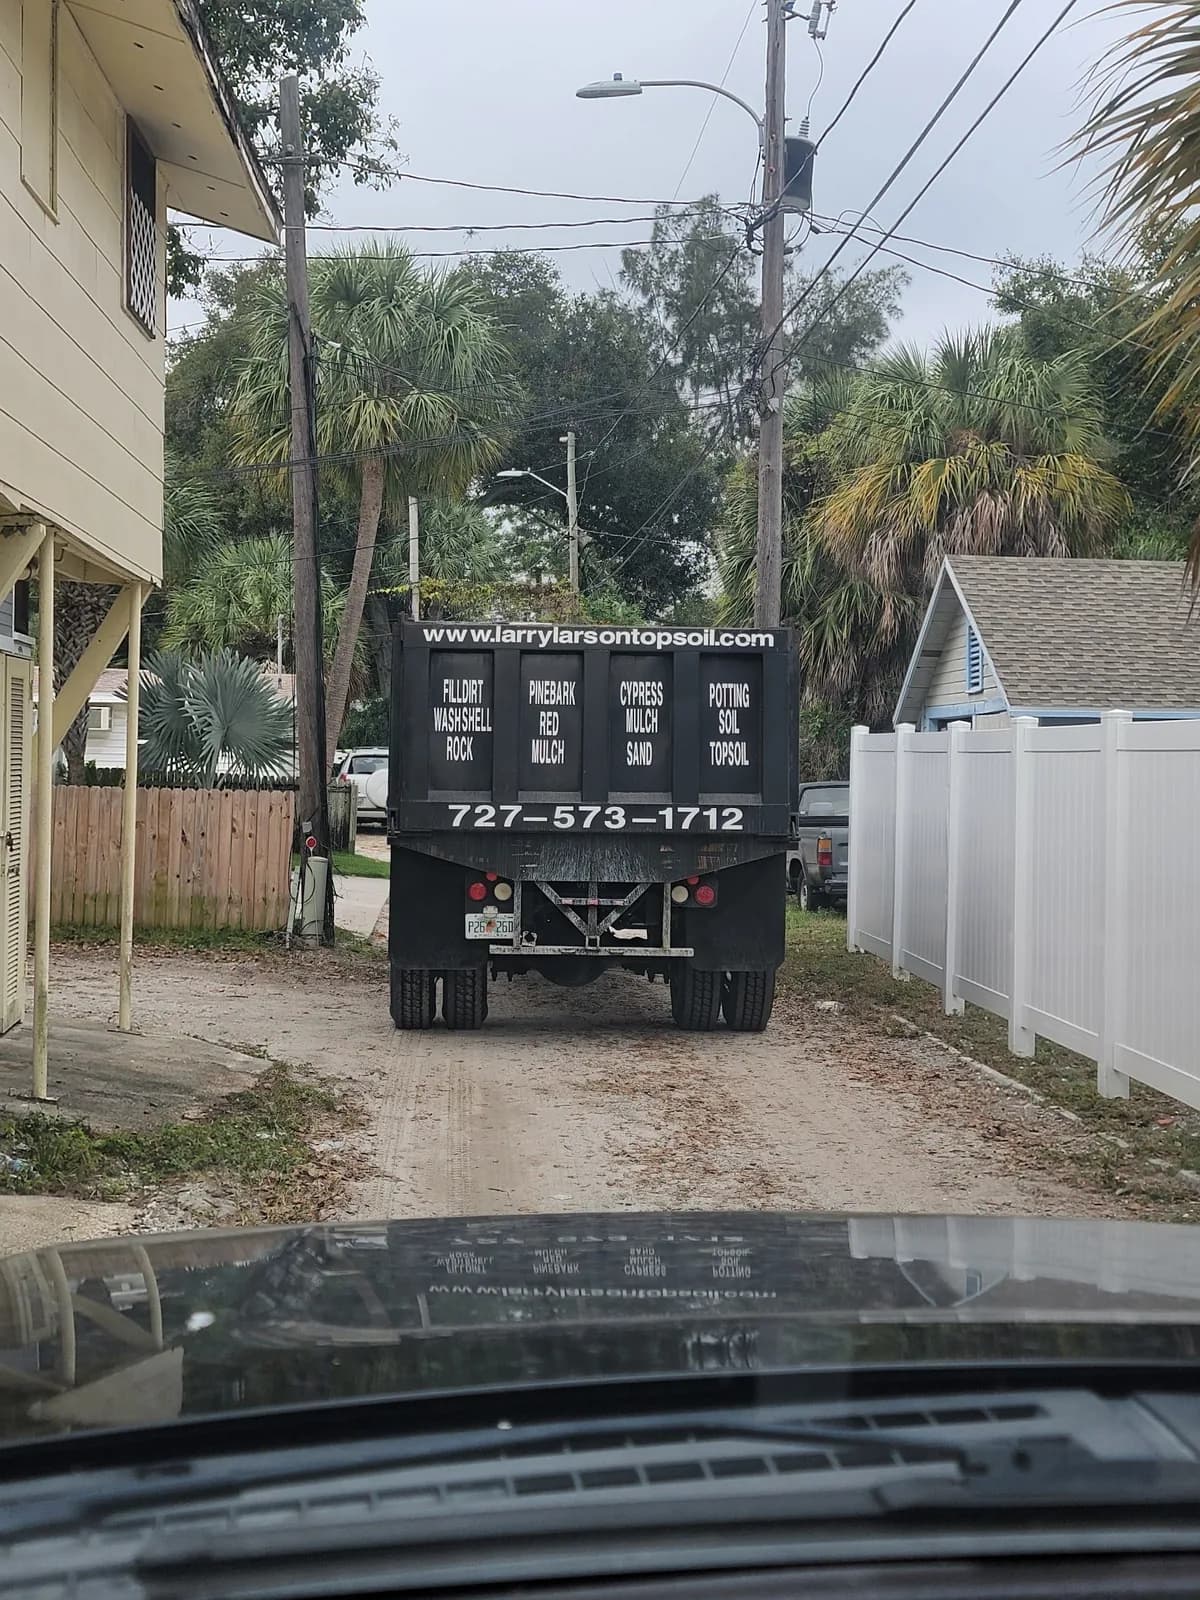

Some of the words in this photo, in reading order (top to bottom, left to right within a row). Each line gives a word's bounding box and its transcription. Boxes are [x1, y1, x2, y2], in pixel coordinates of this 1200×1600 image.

[423, 626, 775, 650] www.larrylarsontopsoil.com
[443, 679, 484, 704] FILLDIRT
[529, 681, 576, 706] PINEBARK
[619, 682, 664, 707] CYPRESS
[709, 683, 750, 709] POTTING
[539, 711, 560, 736] RED
[625, 708, 658, 734] MULCH
[718, 709, 740, 735] SOIL
[446, 736, 474, 761] ROCK
[531, 739, 565, 765] MULCH
[626, 741, 653, 766] SAND
[709, 741, 750, 767] TOPSOIL
[448, 805, 744, 830] 727-573-1712
